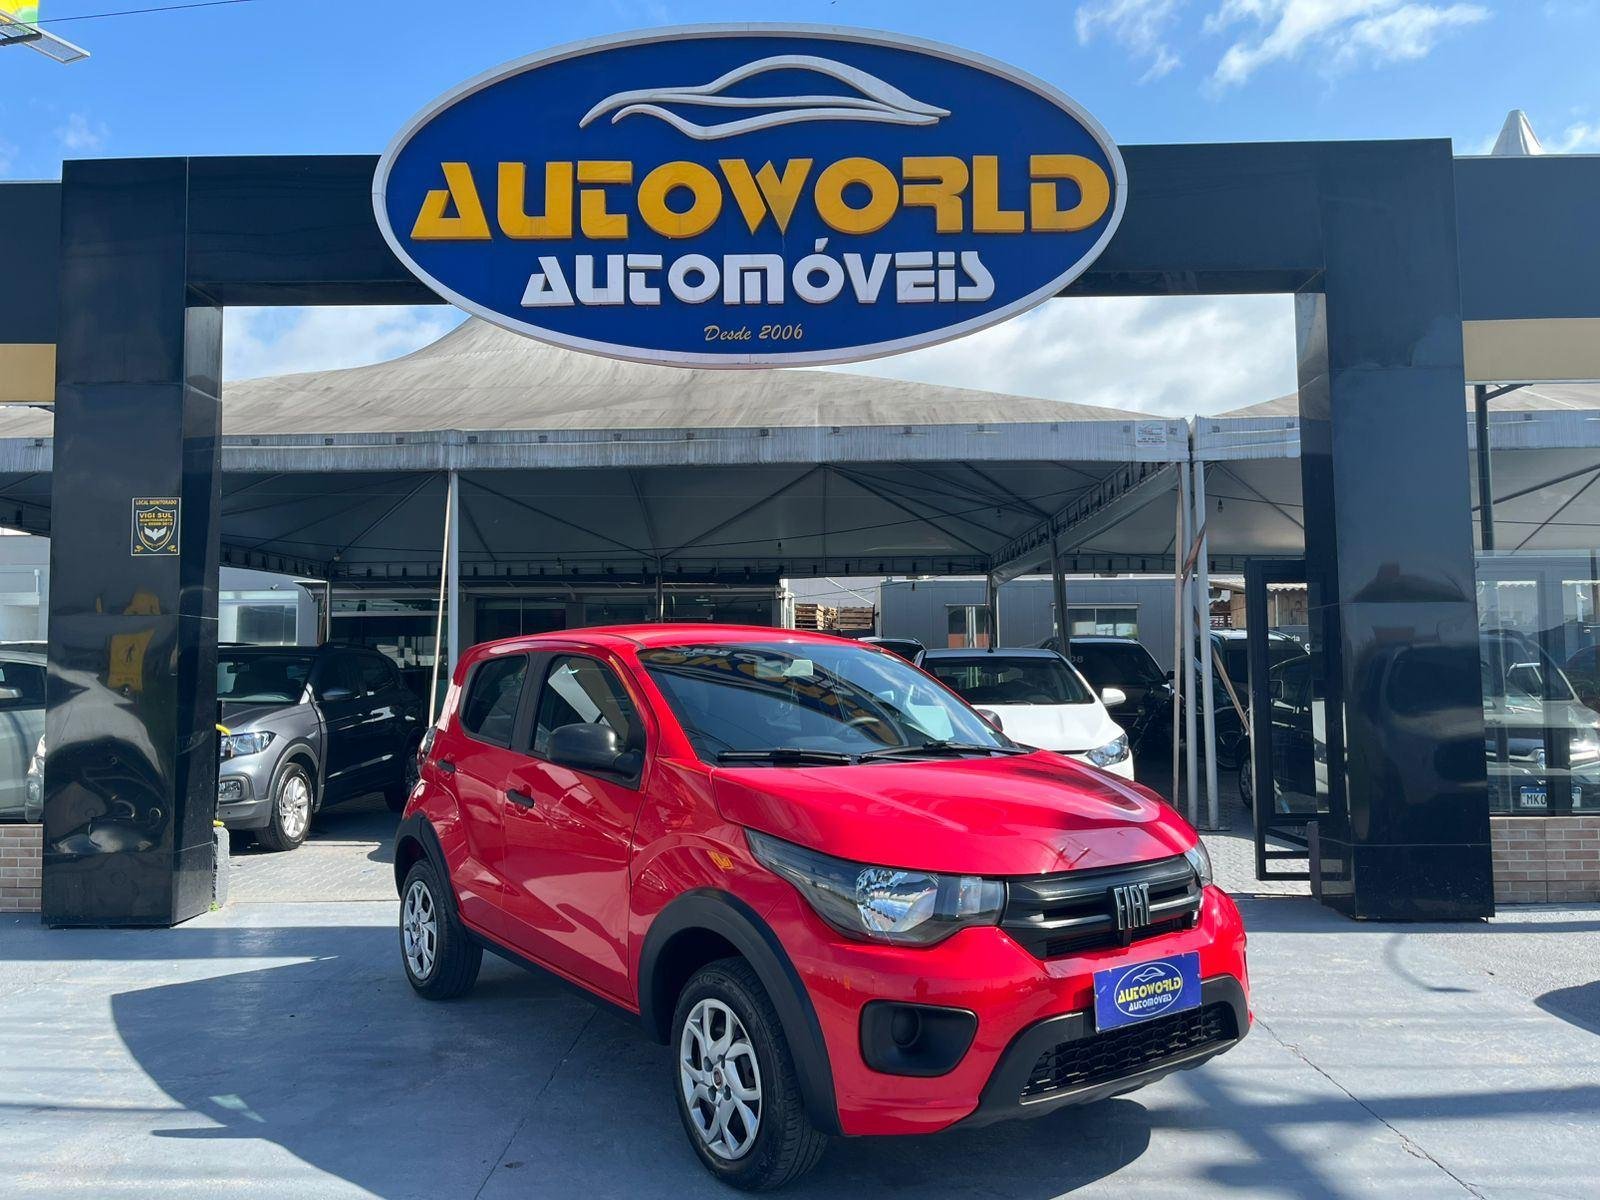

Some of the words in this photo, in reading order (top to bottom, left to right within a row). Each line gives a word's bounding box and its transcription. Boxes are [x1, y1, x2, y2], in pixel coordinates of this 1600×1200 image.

[410, 155, 1111, 240] AUTOWORLD
[520, 238, 996, 307] AUTOMÓVEIS
[704, 325, 752, 341] Desde
[758, 324, 803, 340] 2006
[1114, 883, 1151, 930] FIAT
[1117, 976, 1181, 1004] AUTOWORLD
